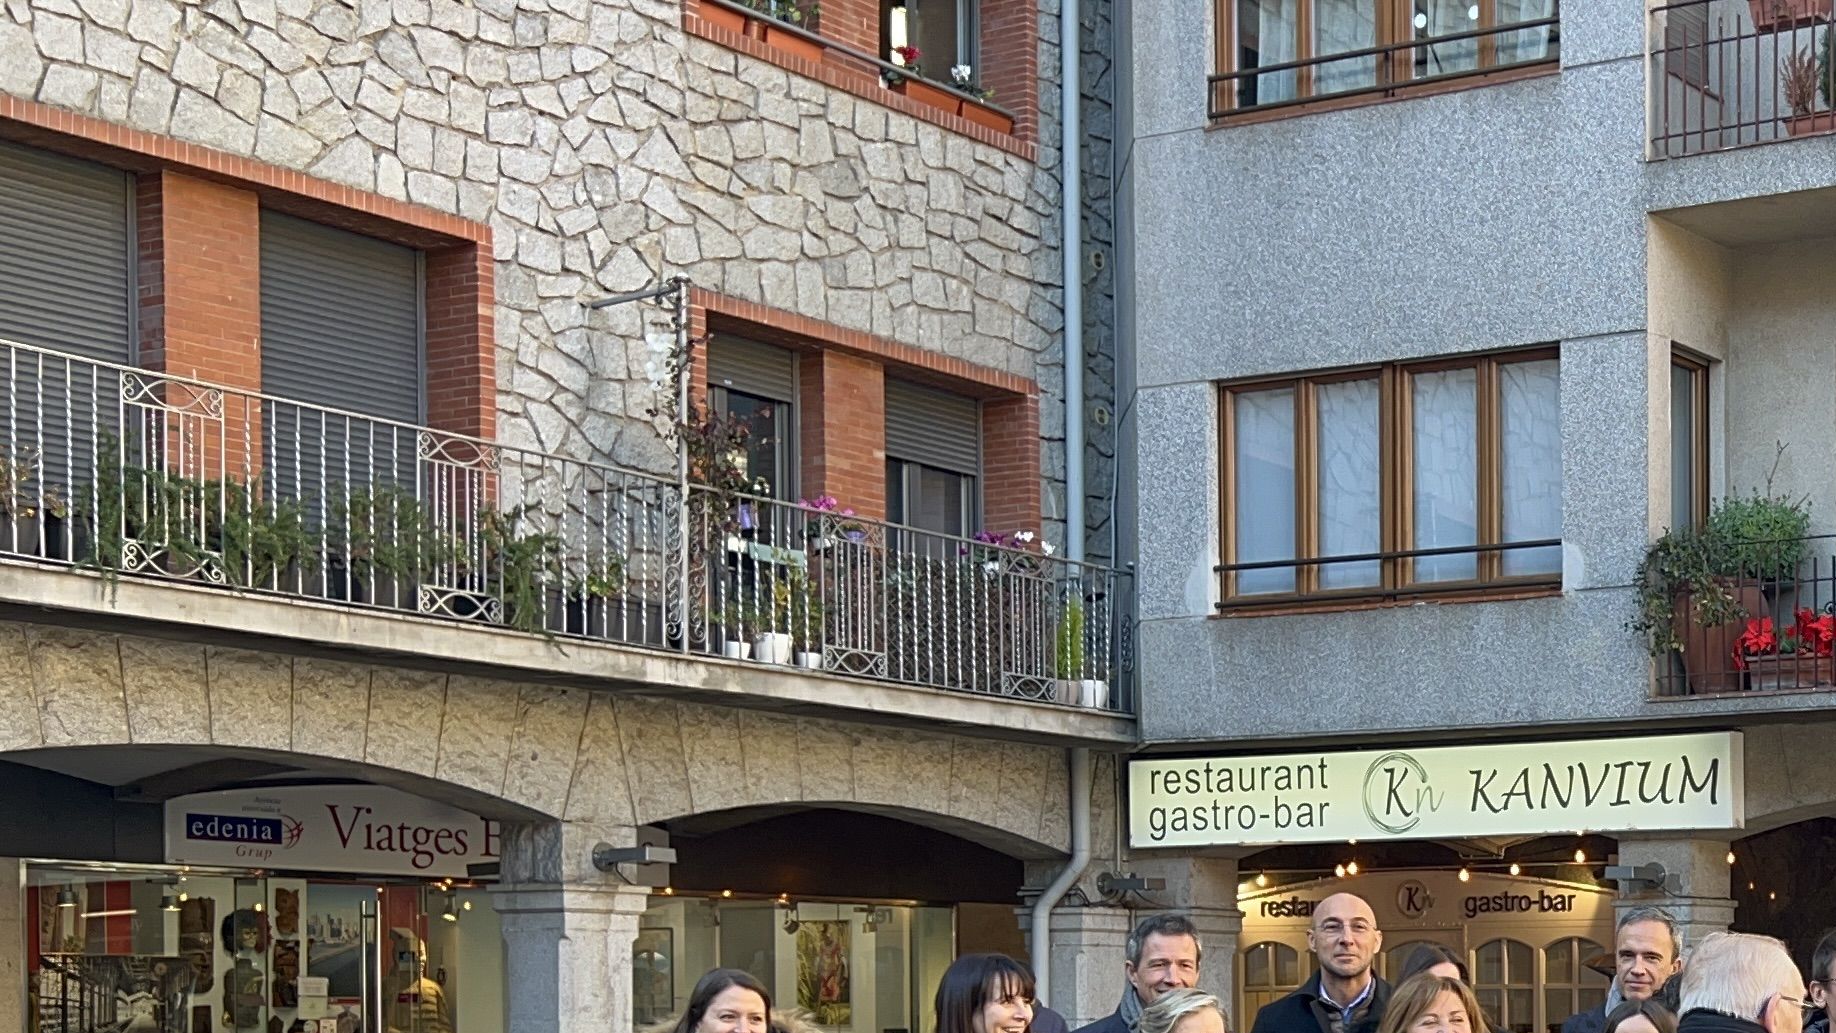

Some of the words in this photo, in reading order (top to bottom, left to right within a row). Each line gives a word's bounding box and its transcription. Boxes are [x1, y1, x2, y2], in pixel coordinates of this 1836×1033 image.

[1149, 757, 1329, 795] restaurant
[1469, 755, 1720, 814] KANVIUM
[191, 816, 273, 841] edenia
[1149, 796, 1331, 842] gastro-bar
[235, 845, 273, 862] Grup
[325, 804, 468, 870] Viatges
[1260, 896, 1322, 918] resta
[1464, 889, 1577, 919] gastro-bar
